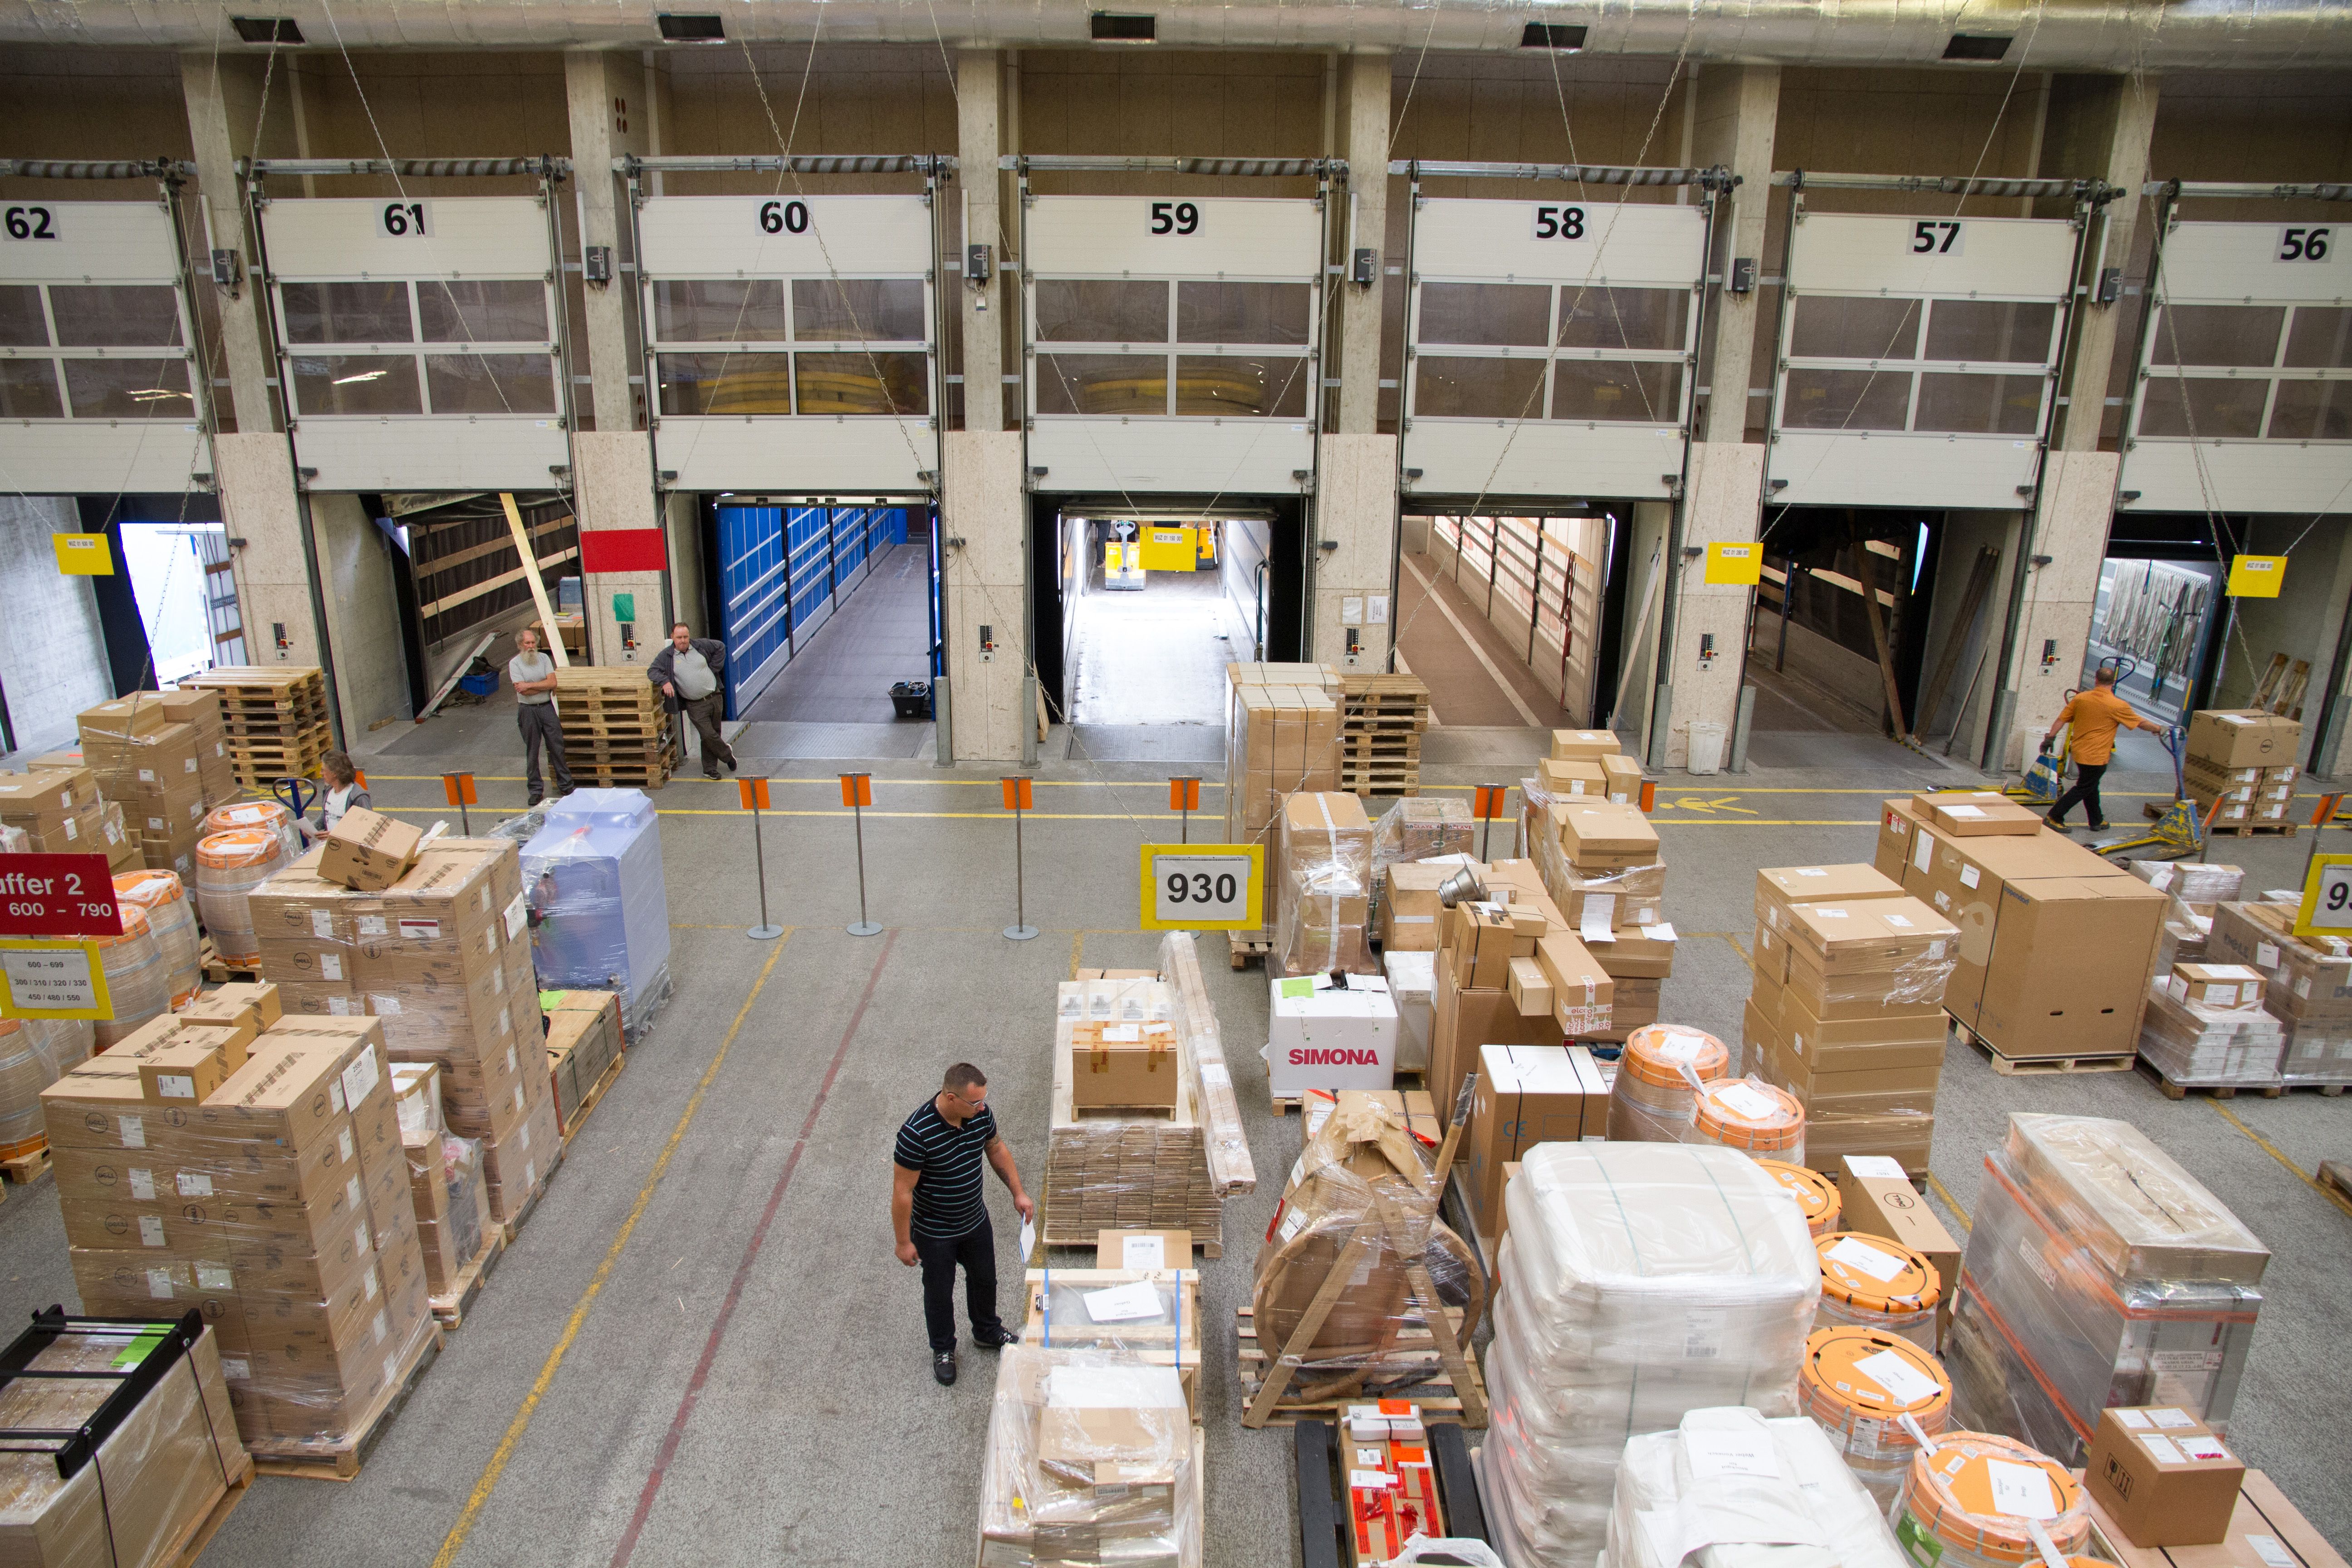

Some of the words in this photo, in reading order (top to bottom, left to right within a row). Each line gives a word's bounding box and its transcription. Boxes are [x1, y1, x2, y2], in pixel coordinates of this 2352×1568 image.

[5, 207, 55, 239] 62
[384, 204, 425, 235] 61
[760, 201, 808, 233] 60
[1152, 203, 1198, 235] 59
[1536, 207, 1584, 239] 58
[1913, 222, 1961, 253] 57
[2281, 229, 2329, 260] 56
[65, 873, 84, 895] 2
[1168, 873, 1236, 903] 930
[2327, 882, 2352, 910] 9
[9, 902, 44, 916] 600
[77, 903, 112, 916] 790
[1289, 1049, 1379, 1066] SIMONA
[315, 1101, 324, 1111] DELL
[324, 1151, 334, 1162] DELL
[1893, 1194, 1906, 1207] DELL
[1825, 1426, 1835, 1434] 920
